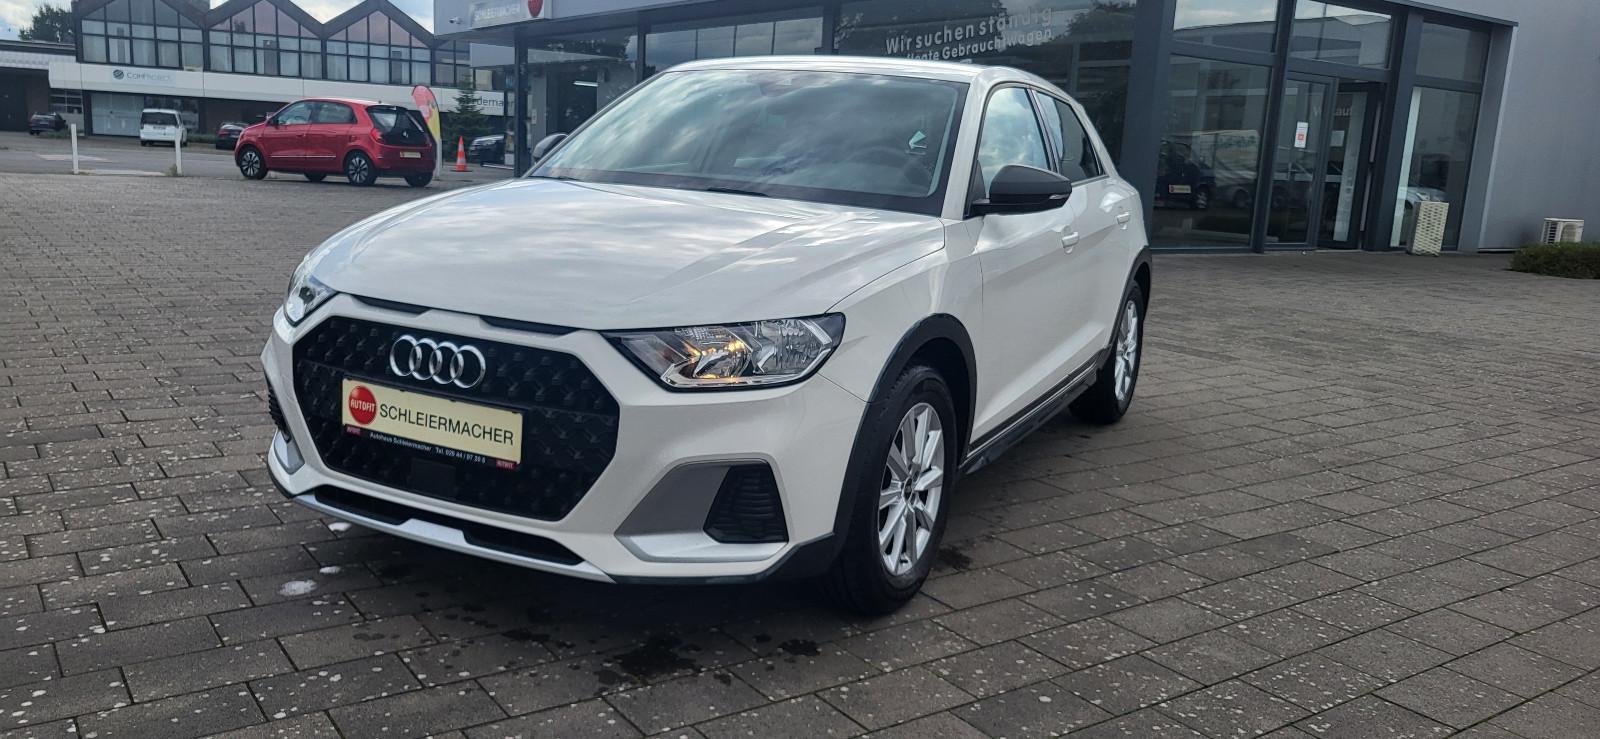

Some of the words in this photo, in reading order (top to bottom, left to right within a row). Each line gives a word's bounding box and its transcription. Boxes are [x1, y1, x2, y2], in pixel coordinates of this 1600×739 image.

[885, 35, 913, 54] Wir
[915, 24, 975, 49] suchen
[978, 6, 1052, 36] ständig
[350, 398, 376, 413] AUTOFIT
[379, 403, 514, 446] SCHLEIERMACHER
[370, 432, 393, 442] Autohaus
[393, 436, 433, 451] Schleiermacher
[435, 446, 445, 454] Tel.
